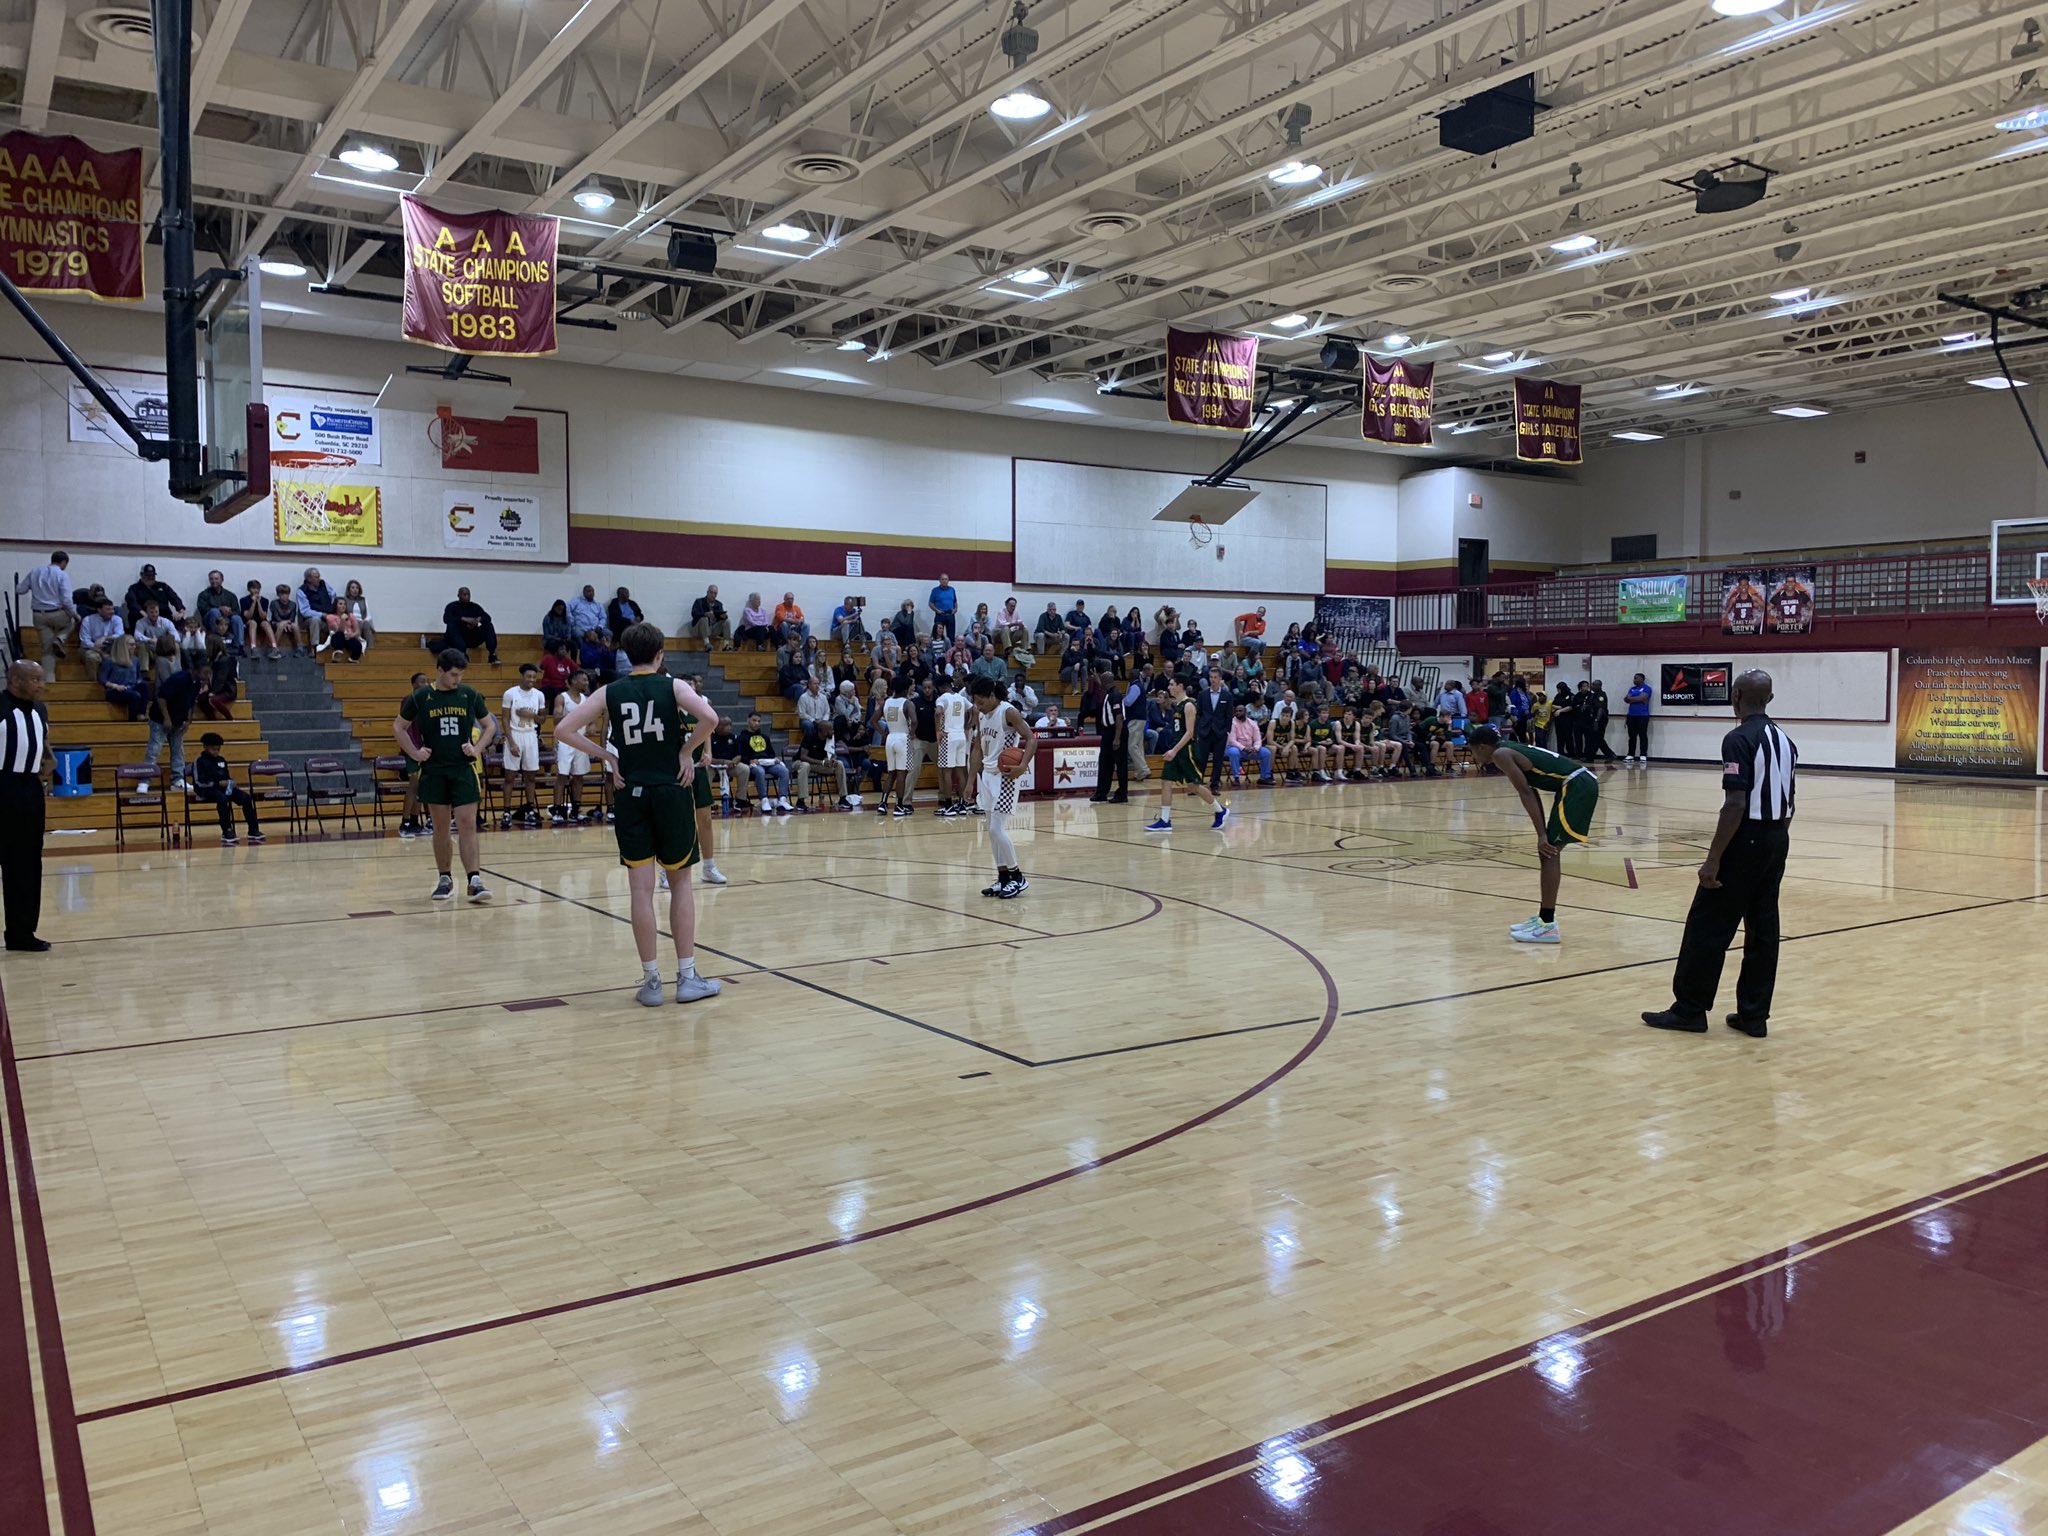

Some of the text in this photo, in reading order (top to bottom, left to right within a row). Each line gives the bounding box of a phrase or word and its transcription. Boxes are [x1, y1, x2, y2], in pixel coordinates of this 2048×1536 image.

[23, 186, 139, 223] CHAMPIONS
[0, 215, 109, 252] YMNASTICS
[10, 249, 89, 277] 1979
[413, 243, 550, 283] STATE CHAMPIONS
[441, 281, 519, 309] SOFTBALL
[446, 311, 516, 340] 1983
[1174, 356, 1249, 380] STATE CHAMPIONS
[1199, 381, 1252, 401] BASKETBALL
[138, 406, 168, 417] GATO
[313, 404, 333, 413] Proudly
[1519, 421, 1540, 436] GIRLS
[484, 494, 502, 502] Proudly
[331, 525, 345, 533] High
[345, 525, 365, 534] School
[1629, 580, 1676, 599] CAROLINA
[1776, 623, 1804, 632] PORTER
[1906, 656, 1944, 665] Columbia
[1983, 656, 2004, 665] Alma
[1927, 668, 1949, 677] Praise
[1960, 668, 1976, 677] thee
[1914, 680, 1931, 689] Our
[1932, 680, 1948, 689] faith
[1949, 680, 1964, 689] and
[1929, 693, 1939, 701] To
[1940, 693, 1953, 704] thy
[1954, 694, 1980, 704] portals
[429, 706, 467, 718] BEN LIPPEN
[1931, 706, 1942, 714] As
[1954, 706, 1986, 717] through
[440, 716, 459, 736] 55
[620, 700, 665, 746] 24
[1930, 718, 1944, 726] We
[1944, 718, 1966, 727] make
[1915, 729, 1931, 737] Our
[1932, 731, 1970, 740] memories
[1971, 731, 1986, 740] will
[1968, 745, 1992, 754] praise
[1908, 753, 1946, 763] Columbia
[1947, 755, 1967, 766] High
[1968, 756, 1997, 765] School
[2002, 757, 2023, 766] Hail!
